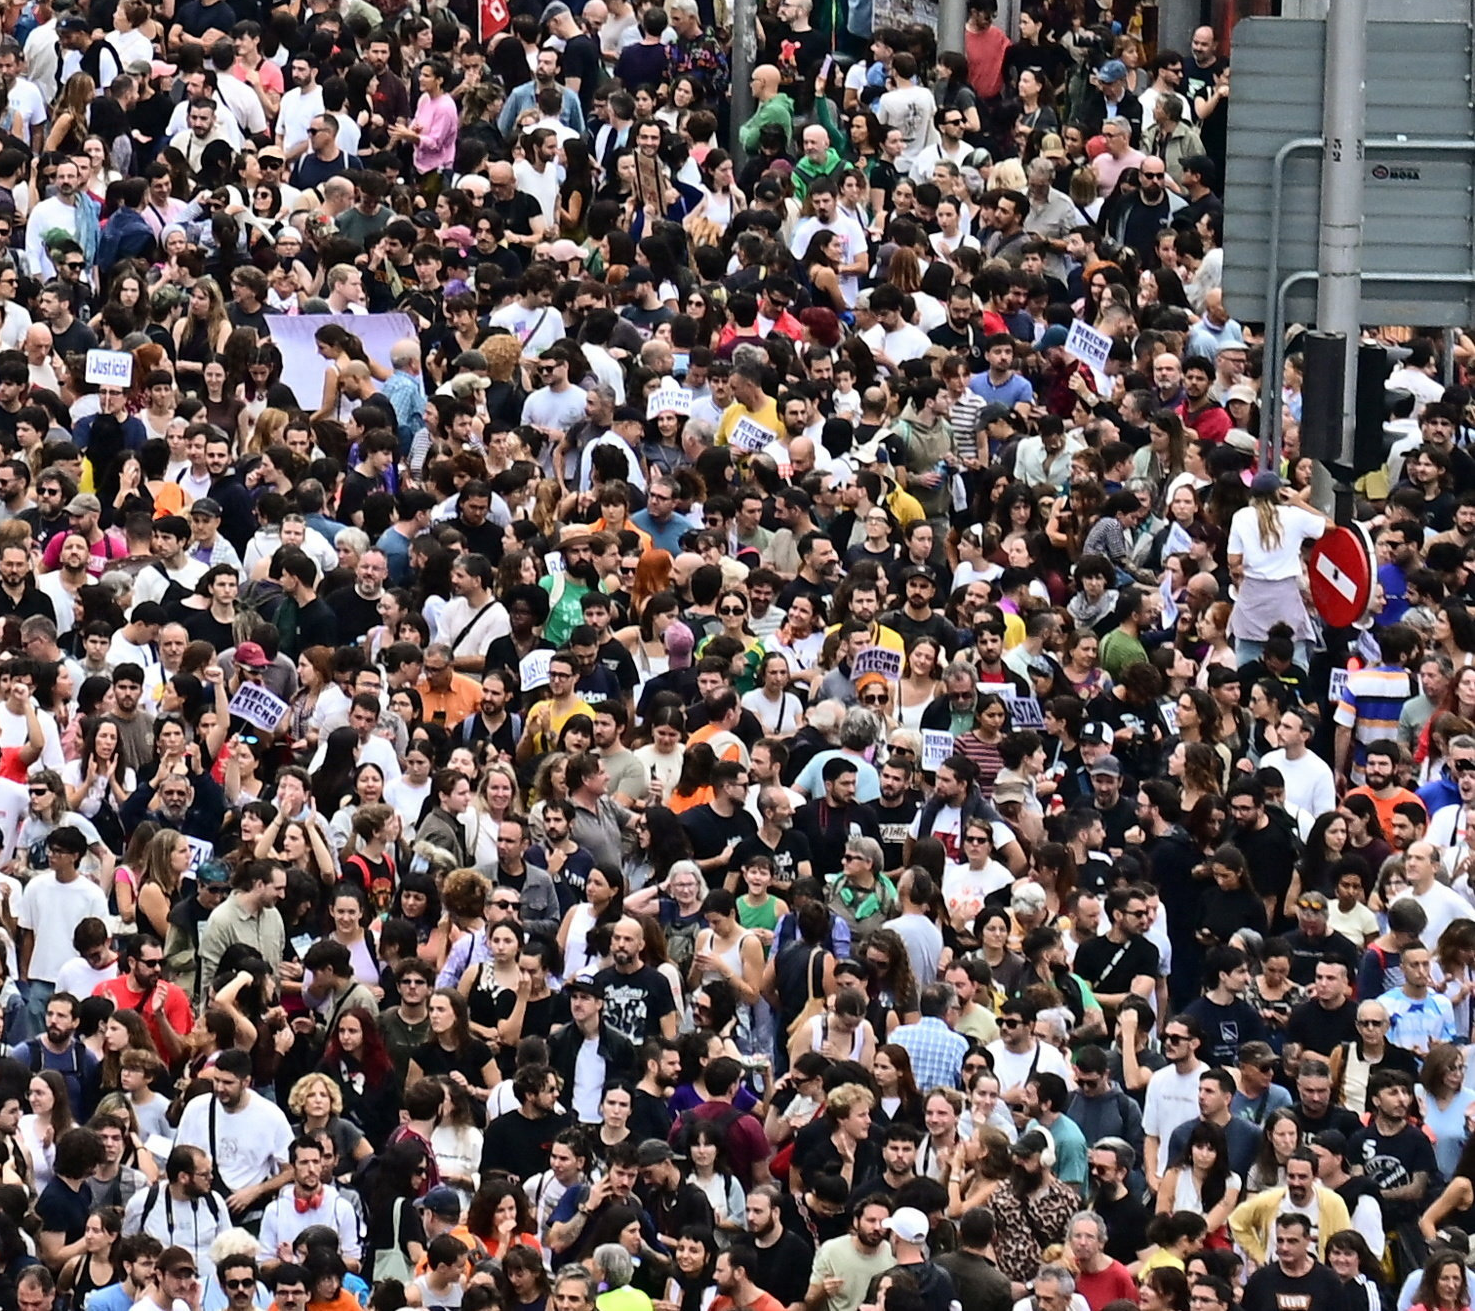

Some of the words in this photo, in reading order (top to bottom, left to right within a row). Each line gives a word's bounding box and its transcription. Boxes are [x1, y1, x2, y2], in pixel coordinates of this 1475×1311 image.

[1076, 326, 1109, 351] DERECHO
[1078, 341, 1105, 360] TECHO
[651, 389, 690, 402] DERECHO
[733, 429, 738, 438] A
[738, 420, 774, 443] DERECHO
[859, 650, 900, 663] DERECHO
[862, 661, 898, 674] TECHO
[240, 686, 282, 716] DERECHO
[233, 696, 240, 705] A
[242, 700, 277, 726] TECHO
[925, 734, 952, 745] DERECHO
